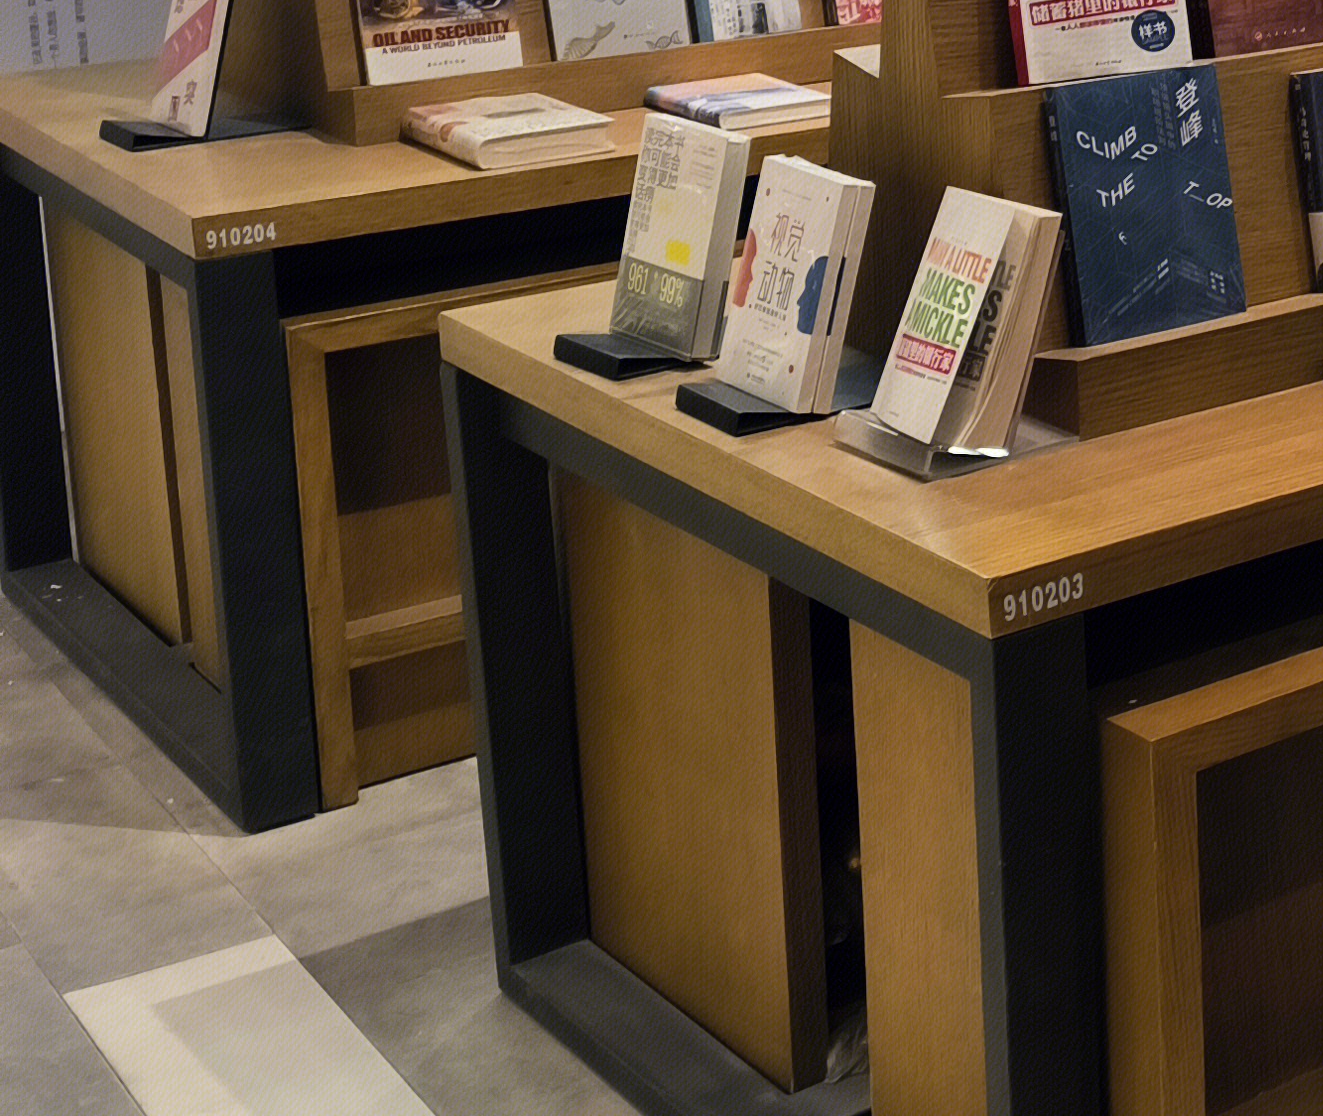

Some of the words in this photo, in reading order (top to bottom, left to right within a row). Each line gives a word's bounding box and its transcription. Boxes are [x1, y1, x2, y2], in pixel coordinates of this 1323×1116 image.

[372, 33, 398, 47] OIL
[397, 28, 433, 45] AND
[434, 19, 510, 41] SECURITY
[1174, 77, 1205, 148] 登峰
[1076, 125, 1137, 161] CLIMB
[1131, 143, 1158, 162] TO
[1096, 172, 1136, 208] THE
[205, 222, 278, 251] 910204
[771, 211, 806, 263] 视觉
[627, 261, 650, 295] 961
[659, 274, 686, 308] 99%
[757, 259, 796, 312] 动物
[1003, 573, 1085, 623] 910203
